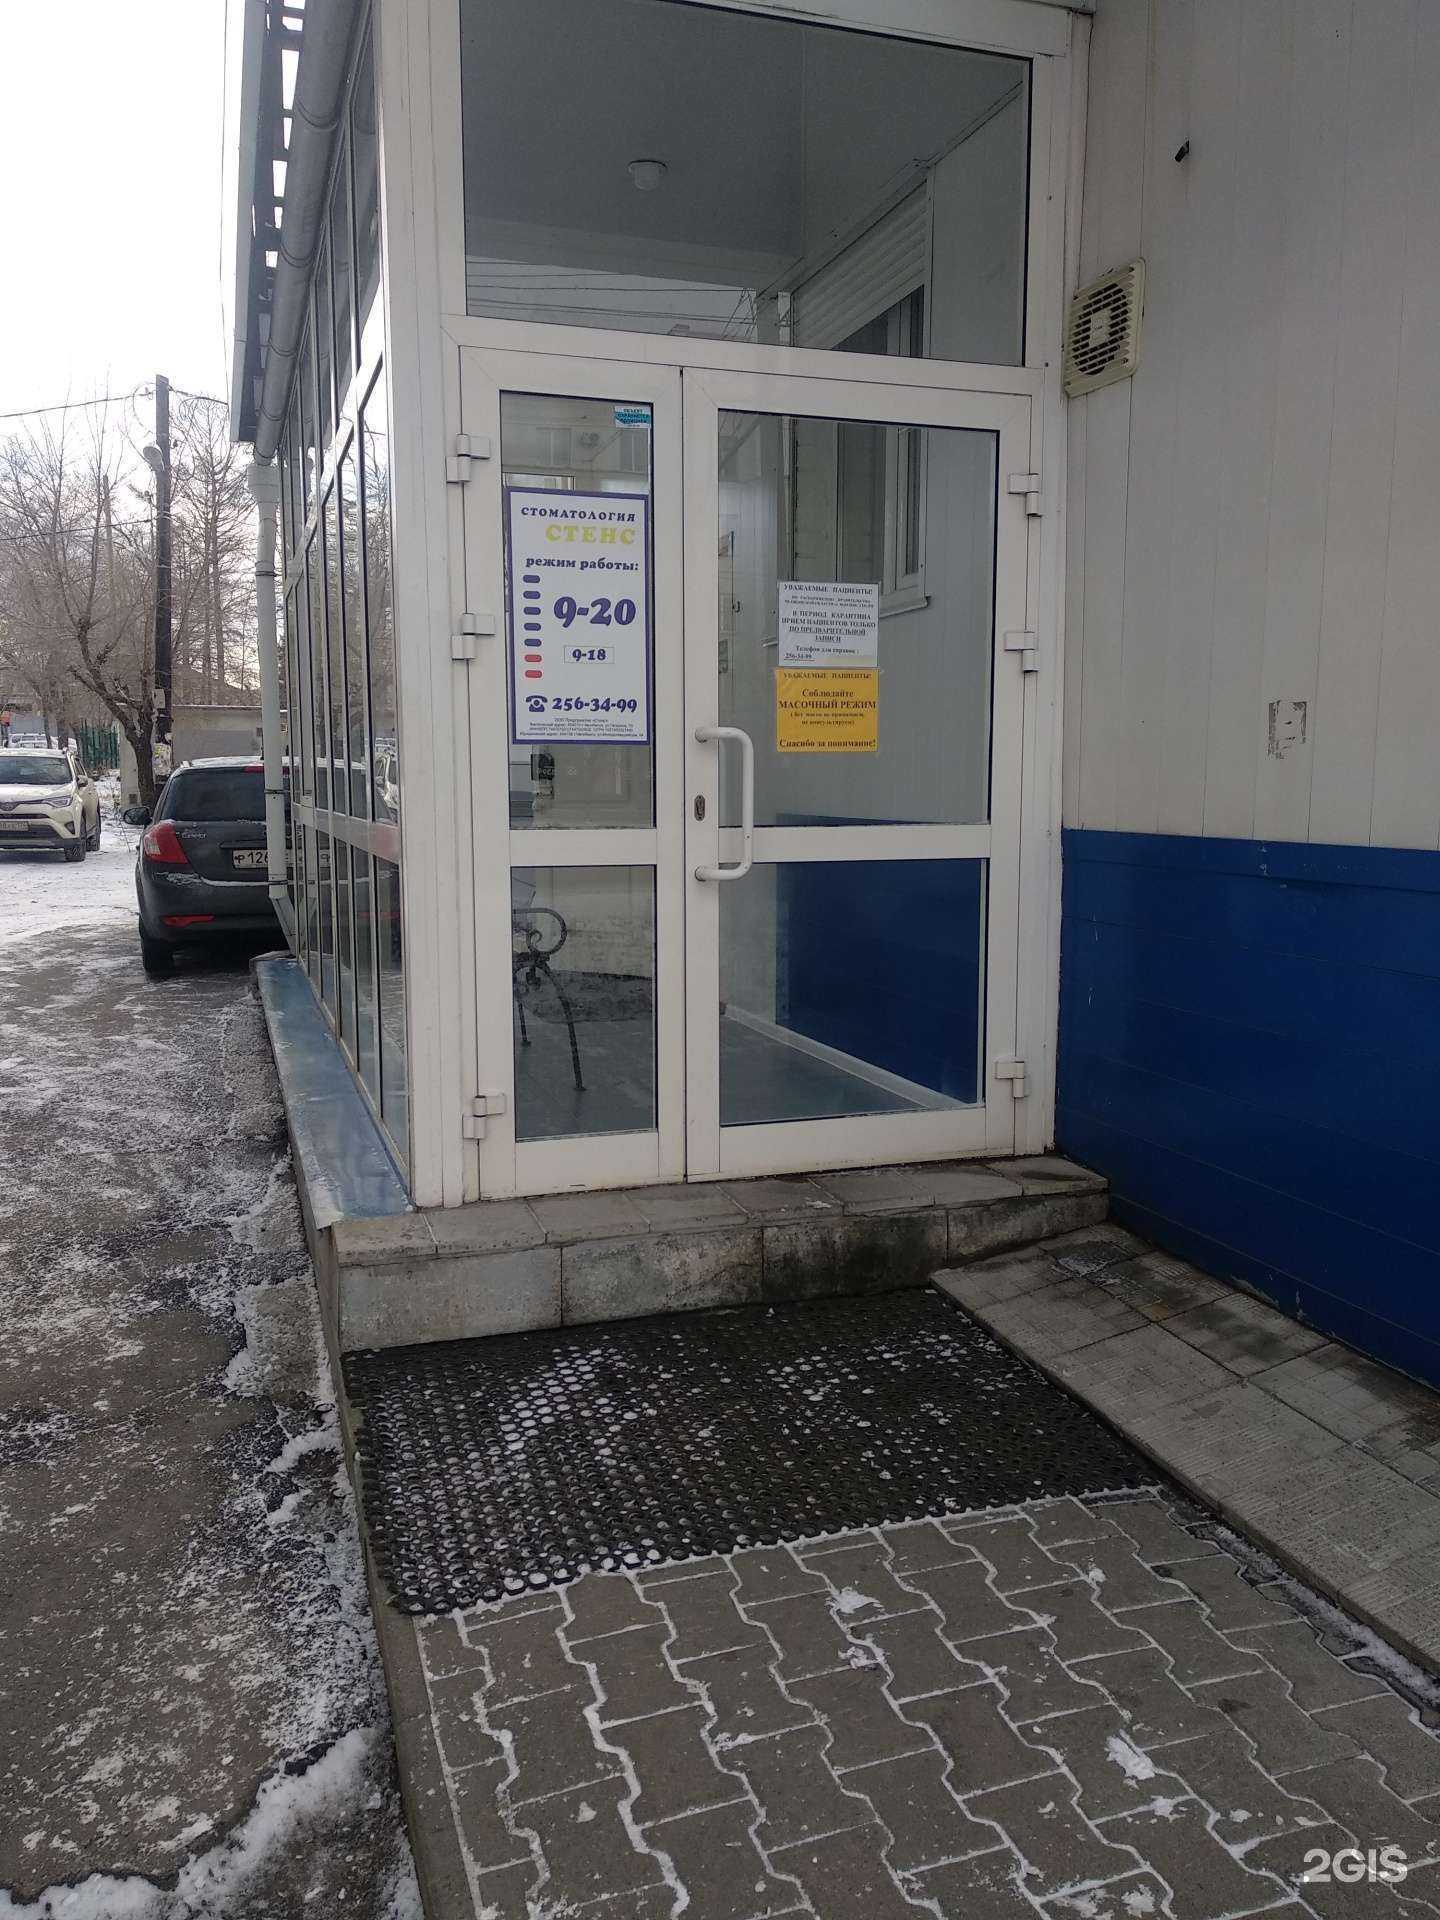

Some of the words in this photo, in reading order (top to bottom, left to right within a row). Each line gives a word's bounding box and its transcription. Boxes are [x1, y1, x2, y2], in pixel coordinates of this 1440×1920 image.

[521, 507, 636, 522] СТОМАТОЛОГИЯ
[546, 524, 636, 545] СТЕНС
[526, 558, 576, 568] режим
[580, 557, 639, 571] работы:
[784, 584, 828, 593] УВАЖАЕМЫЕ
[553, 596, 636, 628] 9-20
[831, 612, 871, 620] КАРАНТИНА
[807, 619, 850, 627] ПАЦИЕНТОВ
[801, 627, 866, 636] ПРЕДВАРИТЕЛЬНОЙ
[572, 648, 606, 662] 9-18
[802, 688, 854, 698] Соблюдайте
[552, 697, 638, 713] 256-34-99
[779, 700, 838, 709] МАСОЧНЫЙ
[840, 701, 876, 709] РЕЖИМ
[779, 739, 815, 748] Спасибо
[827, 739, 876, 748] понимание!
